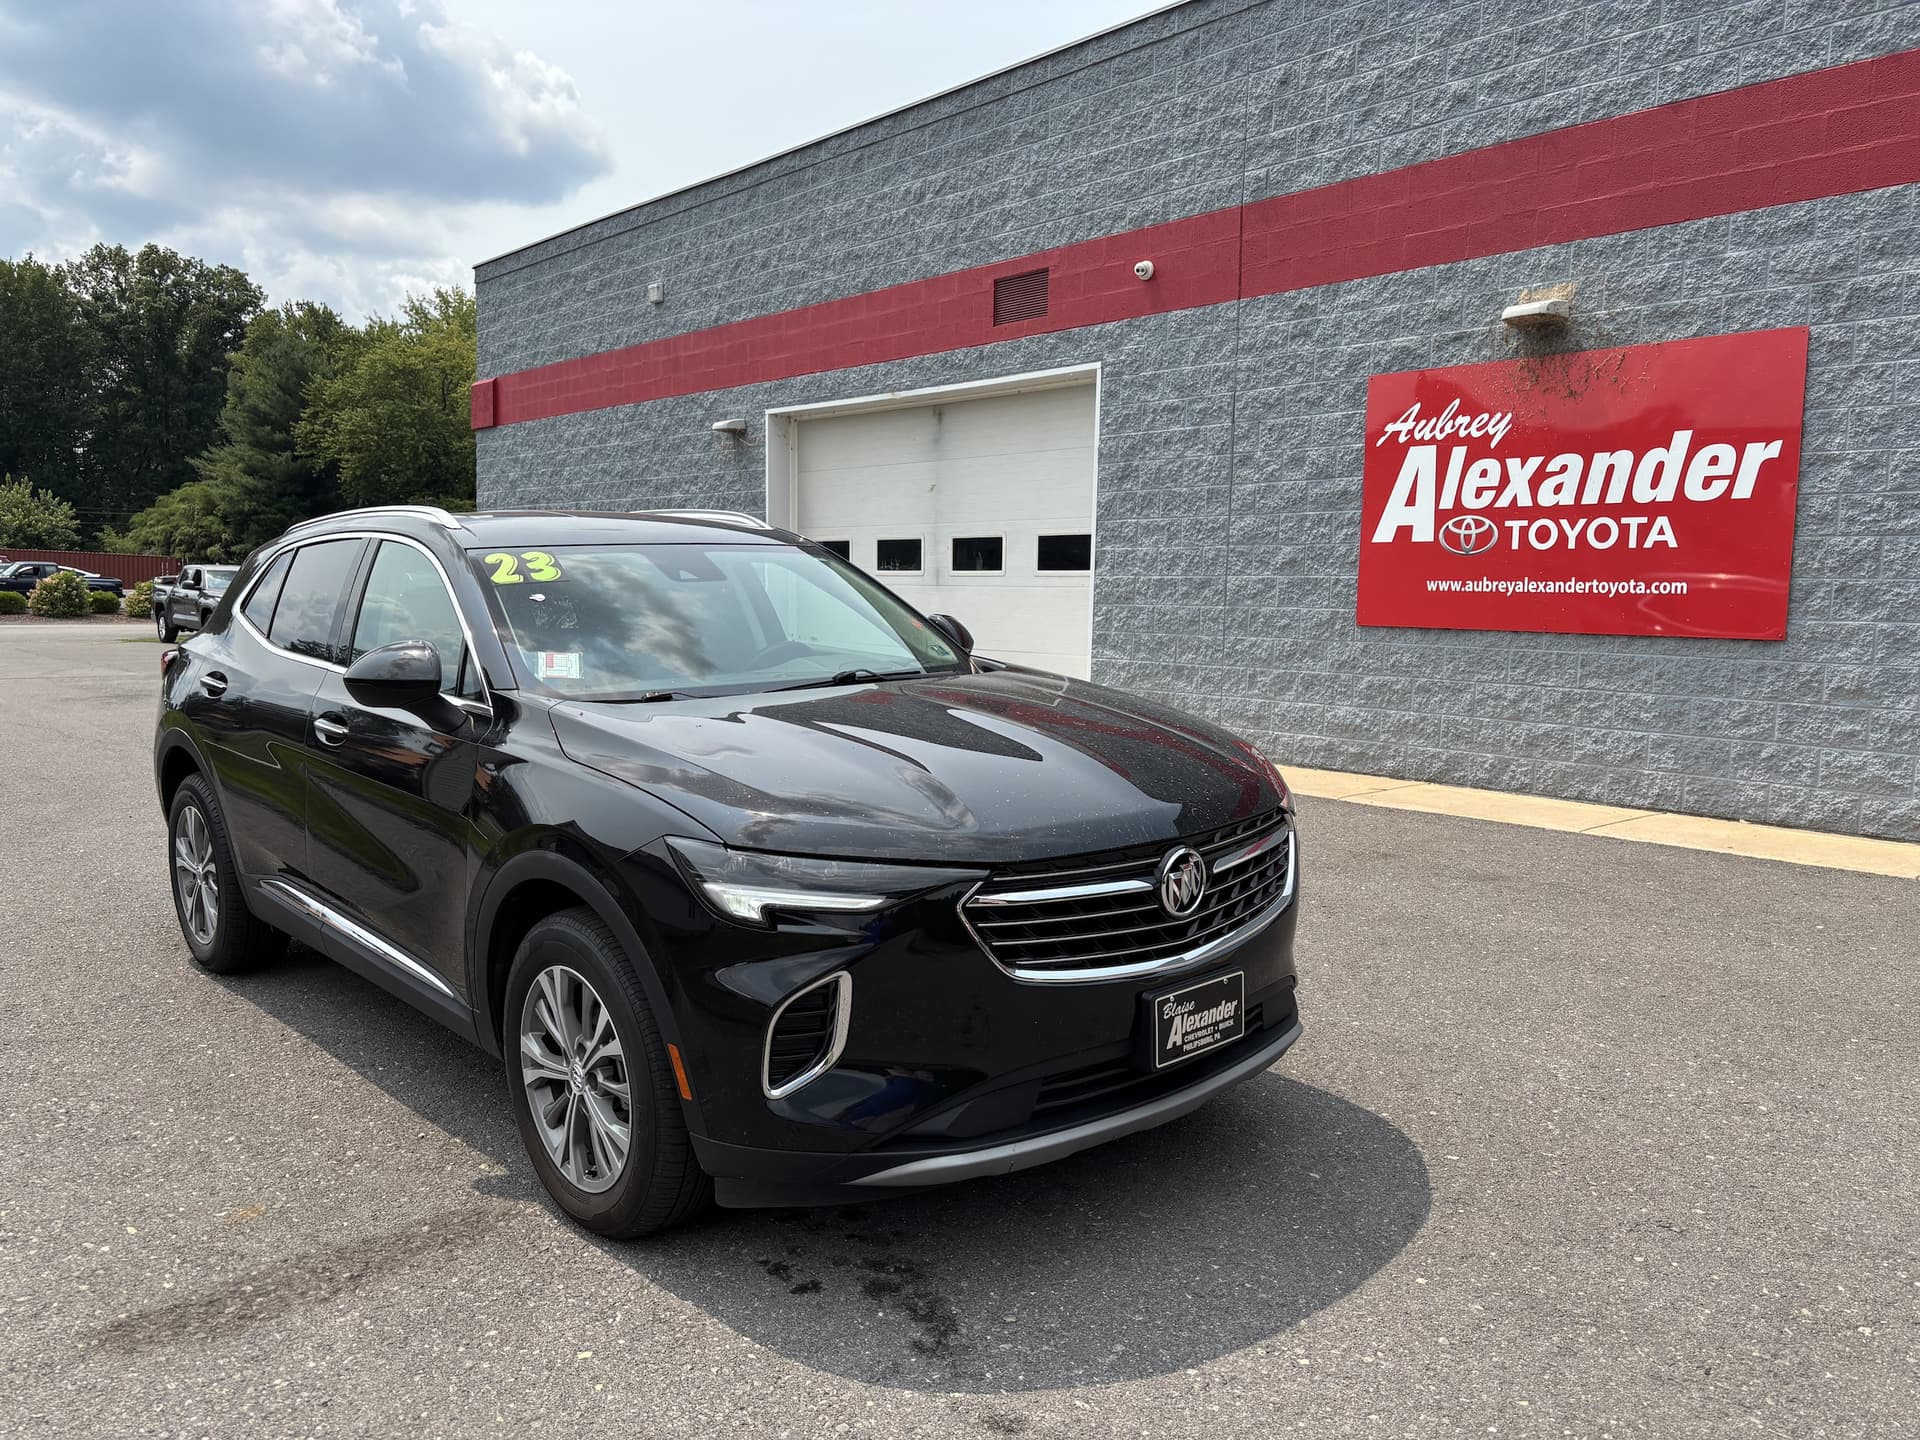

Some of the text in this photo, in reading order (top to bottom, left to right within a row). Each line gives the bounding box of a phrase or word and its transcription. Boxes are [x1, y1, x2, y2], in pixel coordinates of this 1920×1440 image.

[1376, 398, 1512, 449] Aubrey
[1372, 430, 1783, 543] Alexander
[1504, 515, 1678, 549] TOYOTA
[484, 552, 561, 585] 23
[1427, 577, 1687, 597] www.aubreyalexandertoyota.com
[1163, 1001, 1195, 1019] Blaise
[1166, 1000, 1238, 1050] Alexander
[1184, 1026, 1214, 1042] CHEVROLET
